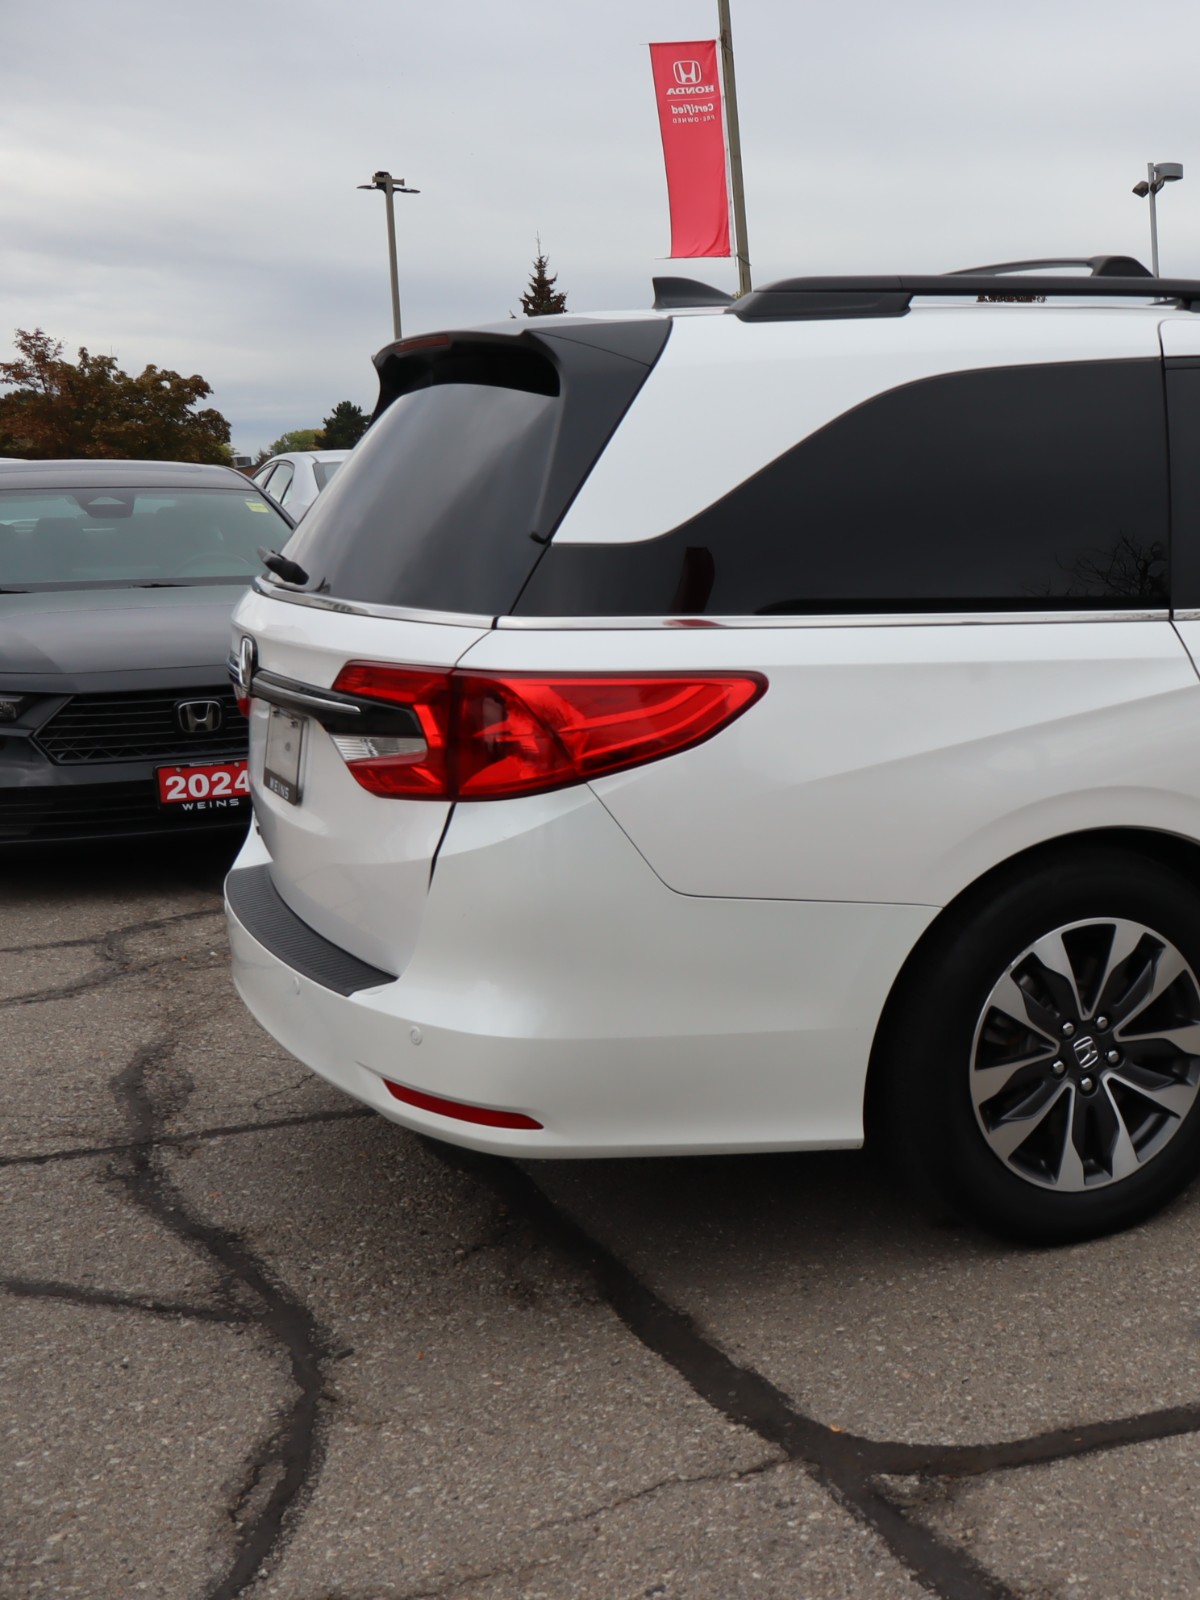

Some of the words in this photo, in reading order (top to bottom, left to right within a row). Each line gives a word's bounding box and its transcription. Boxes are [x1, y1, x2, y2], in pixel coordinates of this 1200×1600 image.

[165, 769, 251, 800] 2024
[269, 776, 290, 800] WEINS
[182, 798, 240, 811] WEINS
